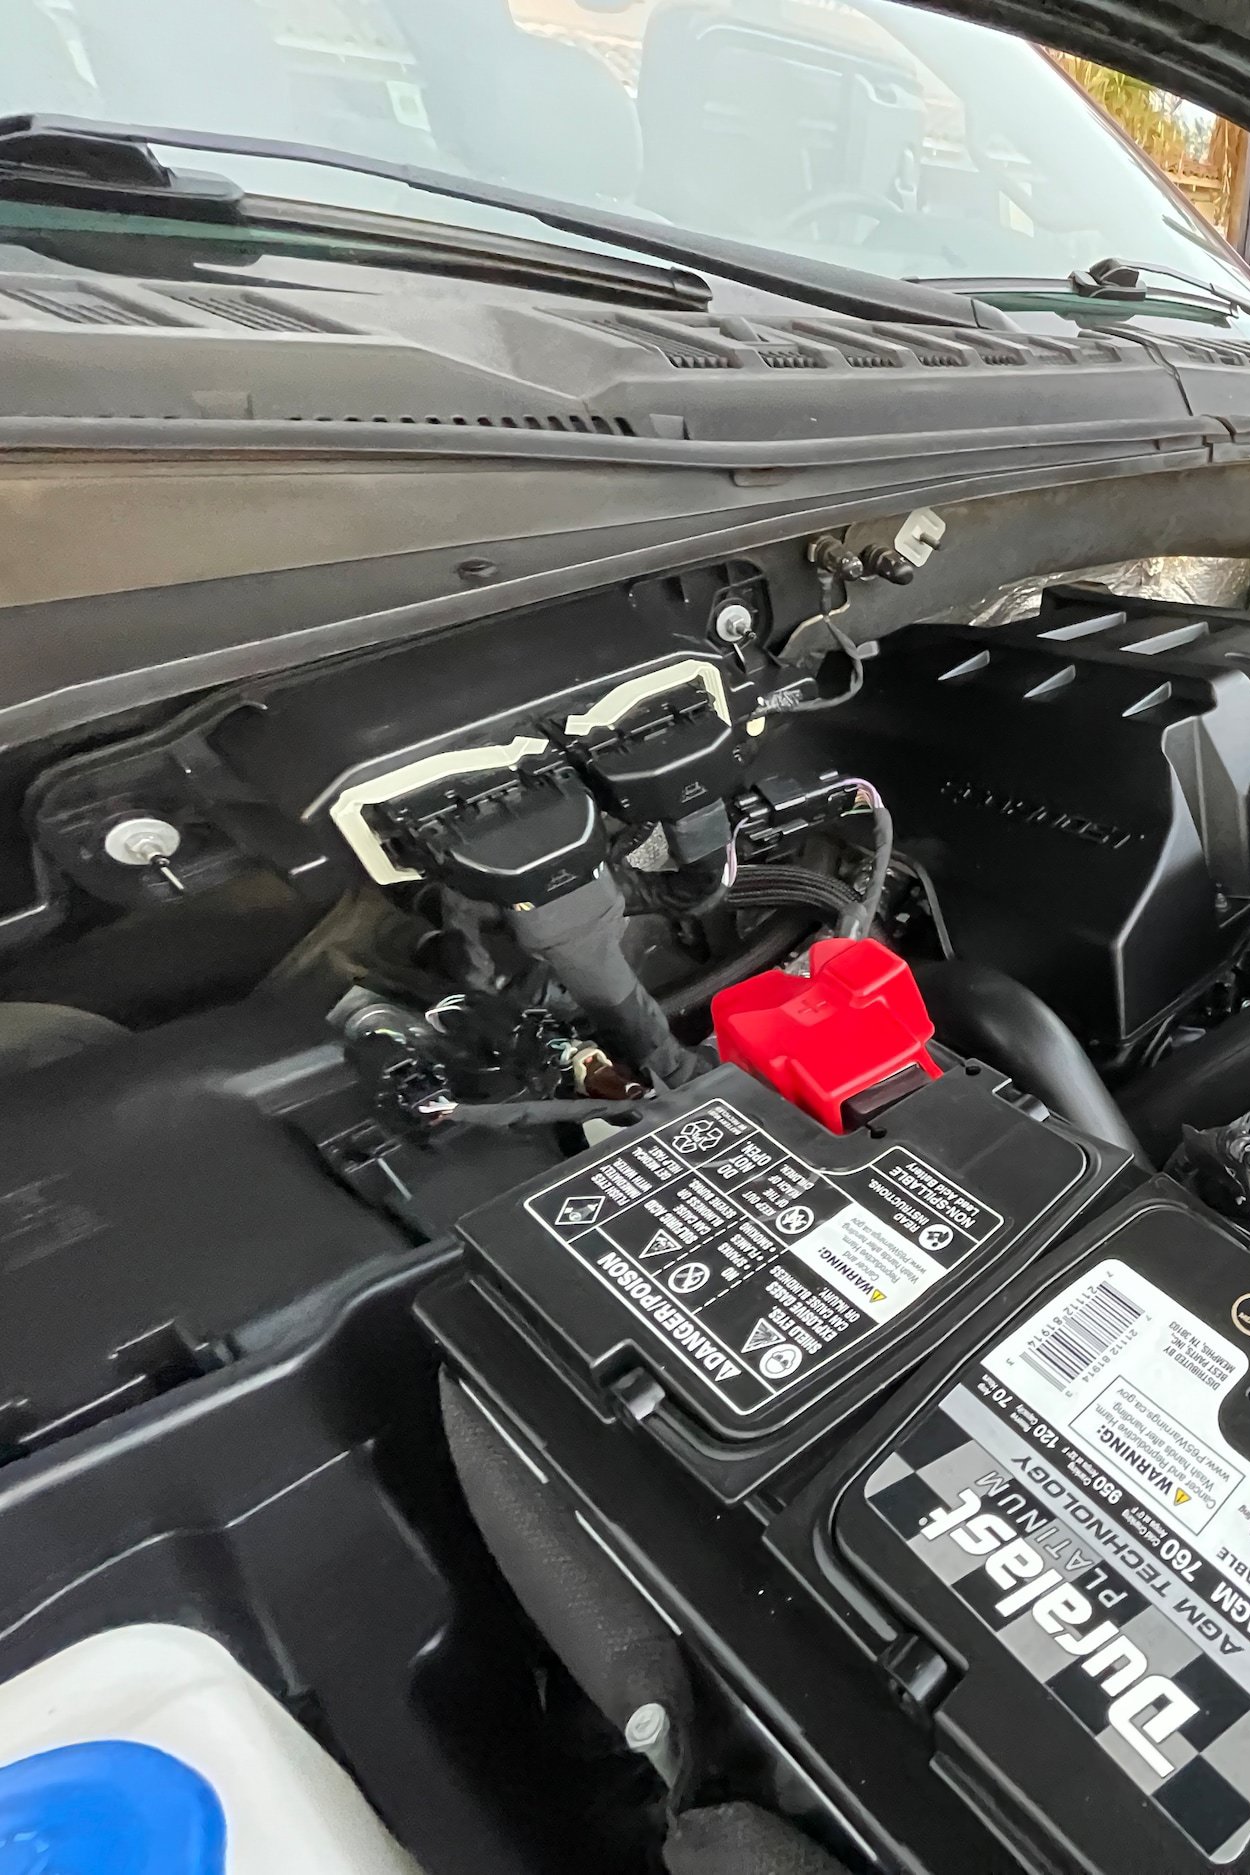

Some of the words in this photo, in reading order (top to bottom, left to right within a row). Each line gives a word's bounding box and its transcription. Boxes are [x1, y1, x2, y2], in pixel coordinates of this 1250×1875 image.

[631, 1145, 660, 1171] MEDICAL
[647, 1144, 669, 1162] FAST.
[728, 1152, 755, 1173] NOT
[740, 1139, 773, 1167] OPEN.
[612, 1156, 638, 1179] WATER.
[653, 1166, 672, 1181] GET
[660, 1157, 683, 1174] HELP
[715, 1161, 738, 1179] DO
[778, 1162, 814, 1191] CHILDREN.
[904, 1161, 939, 1187] Battery
[589, 1171, 612, 1189] EYES
[599, 1163, 642, 1199] IMMEDIATELY
[630, 1174, 652, 1192] WITH
[687, 1177, 715, 1201] BURNS.
[767, 1172, 783, 1185] OF
[776, 1179, 801, 1199] REACH
[603, 1184, 630, 1206] FLUSH
[675, 1186, 693, 1200] OR
[741, 1189, 761, 1204] OUT
[761, 1186, 781, 1201] THE
[773, 1196, 790, 1208] OF
[866, 1177, 930, 1226] INSTRUCTIONS.
[887, 1164, 976, 1228] NON-SPILLABLE
[933, 1182, 958, 1200] Acid
[642, 1197, 668, 1217] ACID
[671, 1202, 699, 1224] CAUSE
[685, 1194, 724, 1228] BLINDNESS
[707, 1195, 737, 1220] SEVERE
[754, 1199, 776, 1217] KEEP
[953, 1196, 980, 1216] Lead
[658, 1210, 698, 1245] SULFURIC
[690, 1218, 712, 1236] CAN
[892, 1211, 920, 1233] READ
[729, 1232, 761, 1259] FLAMES
[737, 1220, 774, 1251] SMOKING
[863, 1239, 882, 1254] after
[716, 1240, 748, 1267] SPARKS
[841, 1249, 858, 1263] and
[857, 1246, 902, 1283] Reproductive
[877, 1249, 902, 1270] hands
[719, 1265, 740, 1281] NO
[768, 1264, 812, 1300] BLINDNESS
[815, 1245, 874, 1296] WARNING:
[854, 1259, 880, 1282] Cancer
[896, 1265, 919, 1285] Wash
[764, 1280, 797, 1307] GASES
[817, 1286, 849, 1314] INJURY.
[595, 1249, 727, 1370] DANGER/POISON
[766, 1304, 796, 1331] EYES.
[804, 1295, 834, 1319] CAUSE
[843, 1308, 861, 1323] OR
[788, 1300, 838, 1342] EXPLOSIVE
[827, 1313, 850, 1332] CAN
[1168, 1319, 1192, 1340] 38103
[786, 1324, 823, 1354] SHIELD
[1162, 1344, 1177, 1356] BY
[1188, 1335, 1201, 1347] TN
[1184, 1343, 1210, 1368] PARTS,
[1200, 1341, 1236, 1373] MEMPHIS,
[1173, 1351, 1220, 1390] DISTRIBUTED
[1206, 1363, 1228, 1382] BEST
[976, 1380, 992, 1396] Amp
[991, 1386, 1012, 1408] 70
[1092, 1402, 1119, 1427] Harm.
[1032, 1422, 1060, 1450] 120
[1115, 1386, 1231, 1482] www.P65Warnings.ca.gov
[1116, 1421, 1169, 1469] Reproductive
[1143, 1429, 1166, 1449] after
[1093, 1423, 1174, 1495] WARNING:
[1161, 1443, 1191, 1471] hands
[1065, 1460, 1092, 1486] Cranking
[1165, 1464, 1186, 1483] and
[1186, 1465, 1215, 1492] Wash
[1090, 1474, 1124, 1505] 950
[1183, 1478, 1218, 1510] Cancer
[1009, 1454, 1170, 1598] TECHNOLOGY
[1120, 1507, 1148, 1535] Cranking
[1140, 1513, 1152, 1524] at
[1148, 1519, 1168, 1539] Amps
[974, 1468, 1129, 1609] PLATINUM
[1142, 1529, 1161, 1547] Cold
[1158, 1536, 1203, 1582] 760
[918, 1485, 1200, 1779] Duralast
[1171, 1595, 1244, 1656] AGM
